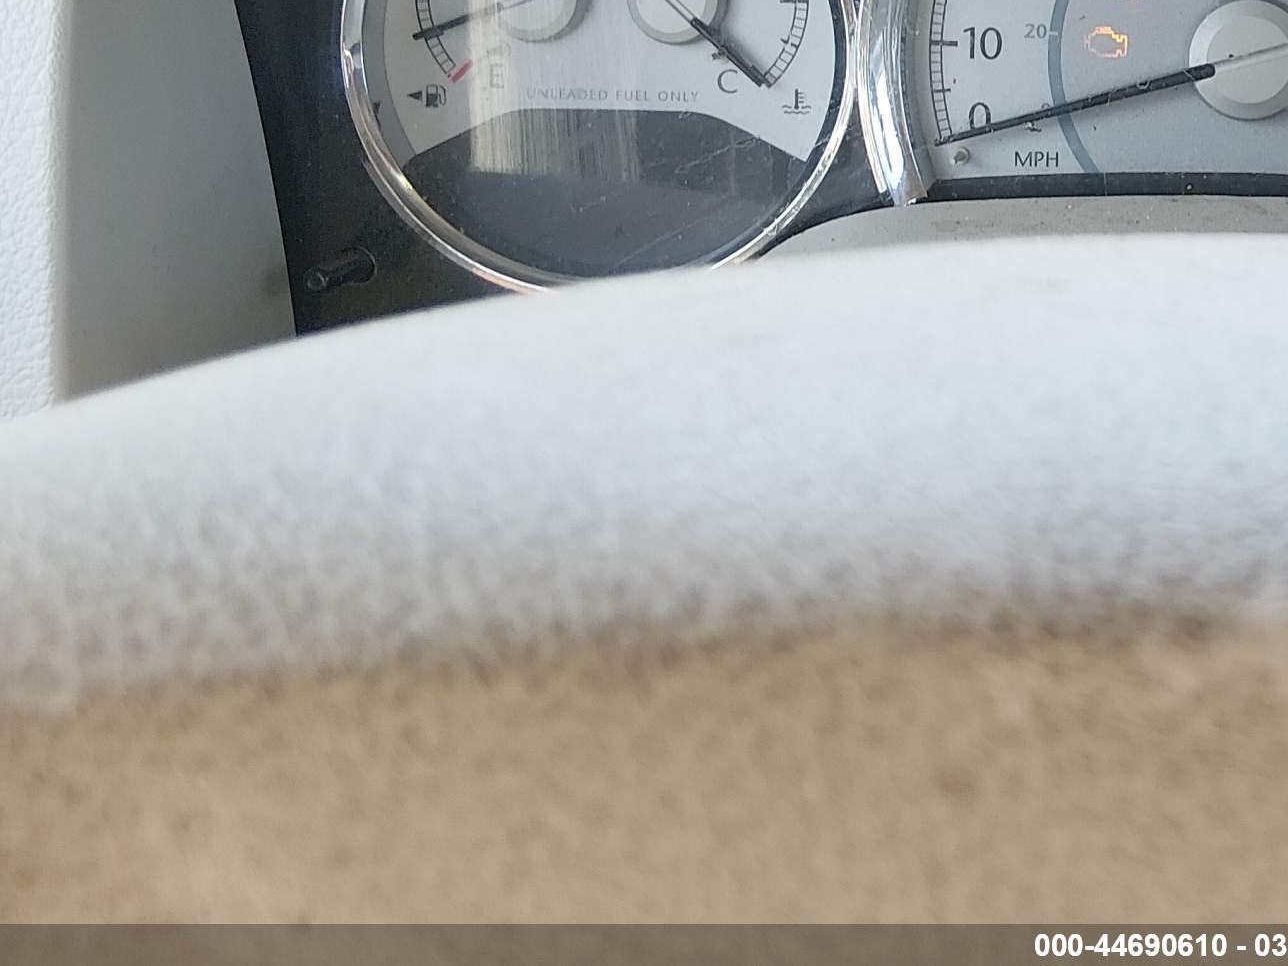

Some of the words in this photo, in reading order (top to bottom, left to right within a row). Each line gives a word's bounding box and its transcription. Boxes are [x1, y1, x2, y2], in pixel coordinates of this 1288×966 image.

[964, 27, 1003, 60] 10
[1024, 24, 1047, 40] 20
[490, 64, 504, 89] E
[716, 70, 739, 94] C
[527, 89, 608, 101] UNLEADED
[616, 90, 652, 102] FUEL
[658, 90, 699, 103] ONLY
[968, 102, 991, 129] 0
[1014, 151, 1059, 168] MPH
